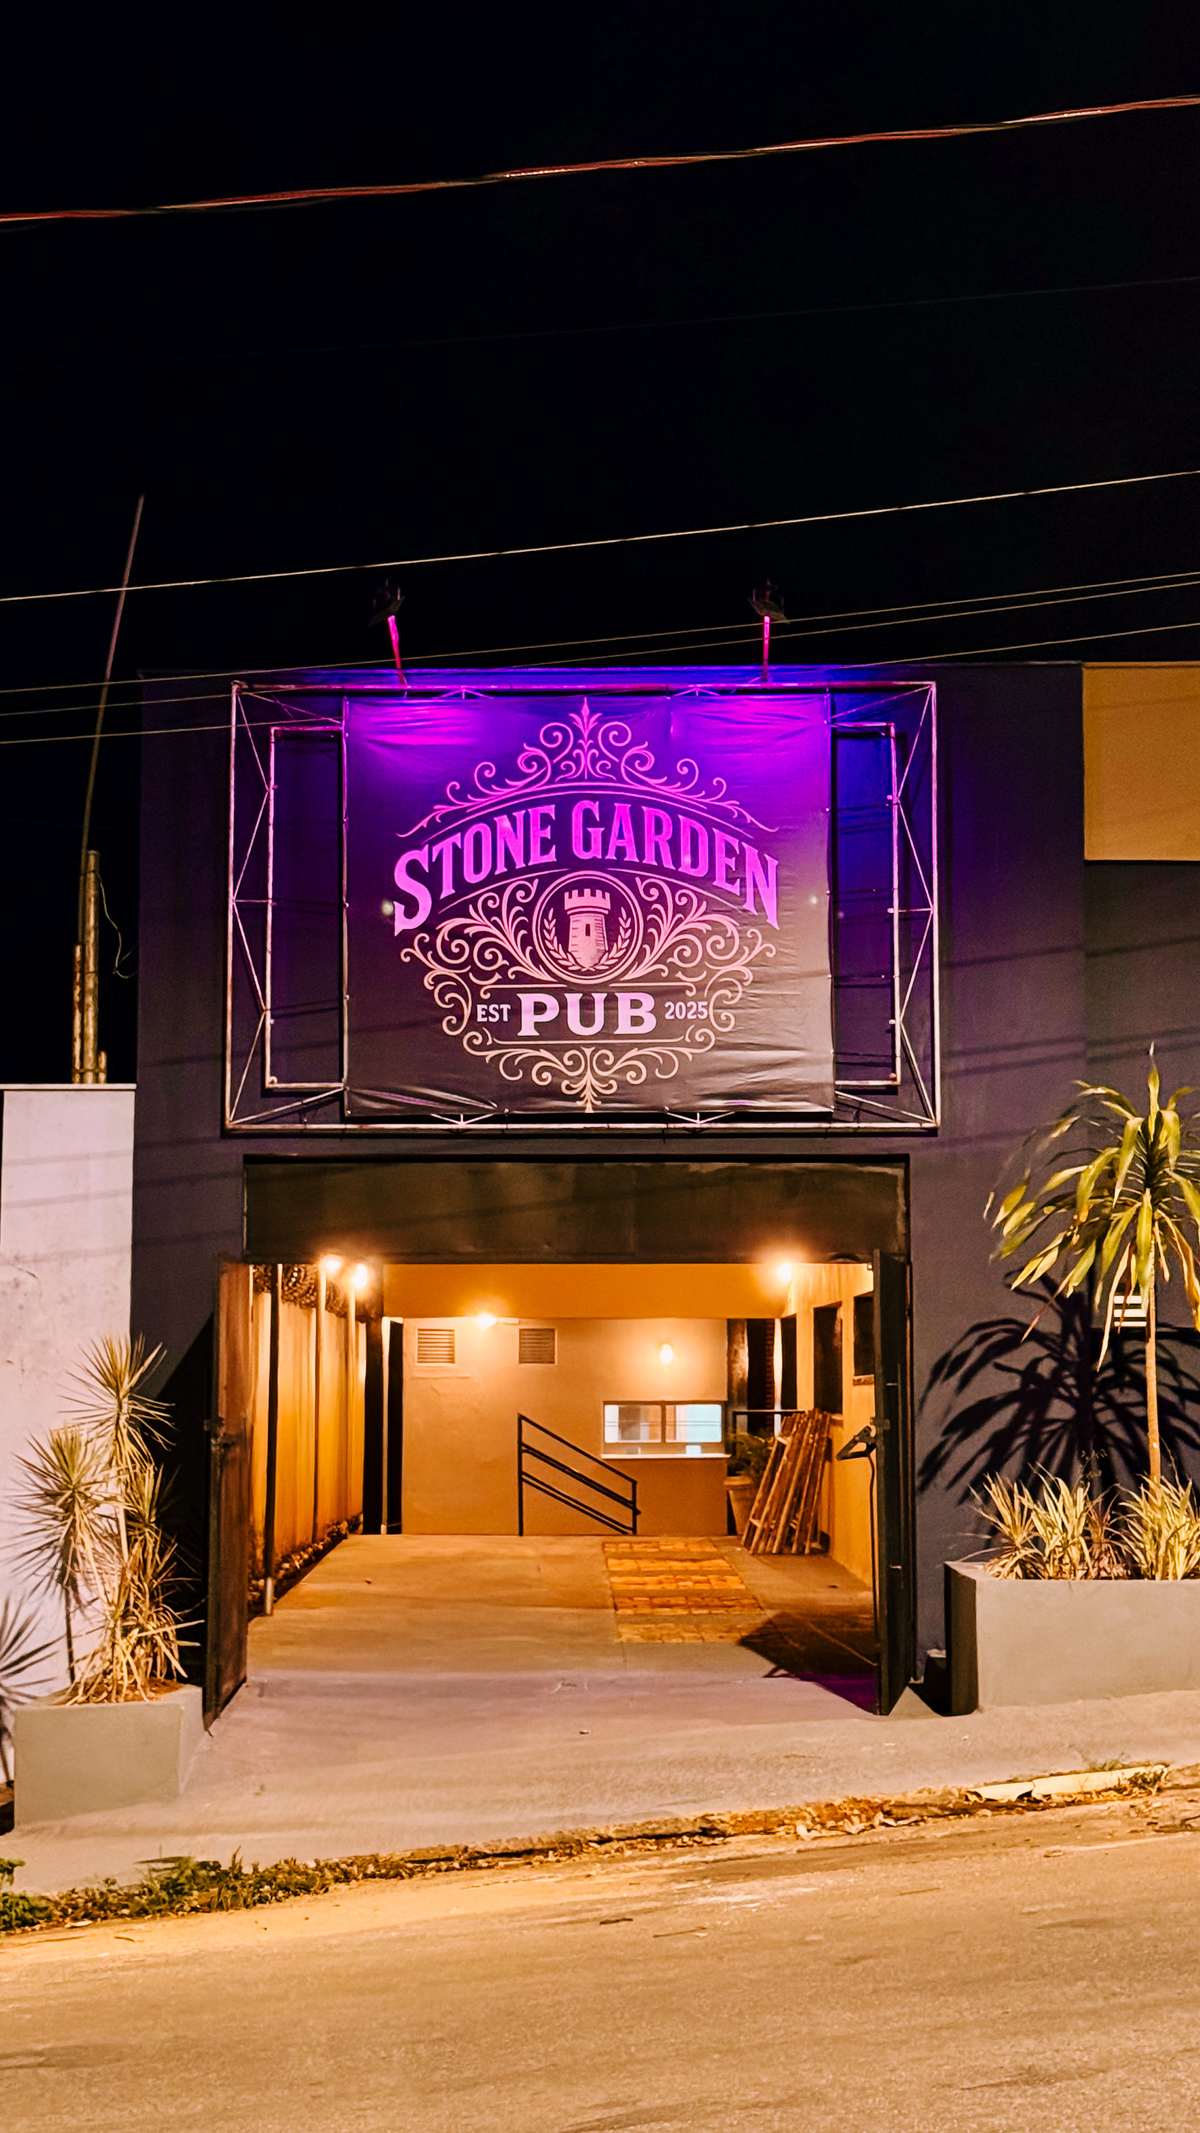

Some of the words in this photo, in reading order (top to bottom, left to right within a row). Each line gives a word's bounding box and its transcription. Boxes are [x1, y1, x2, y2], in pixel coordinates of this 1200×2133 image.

[393, 804, 557, 936] STONE
[571, 799, 780, 931] GARDEN
[476, 1004, 511, 1023] EST
[516, 992, 657, 1036] PUB
[664, 1001, 708, 1020] 2025
